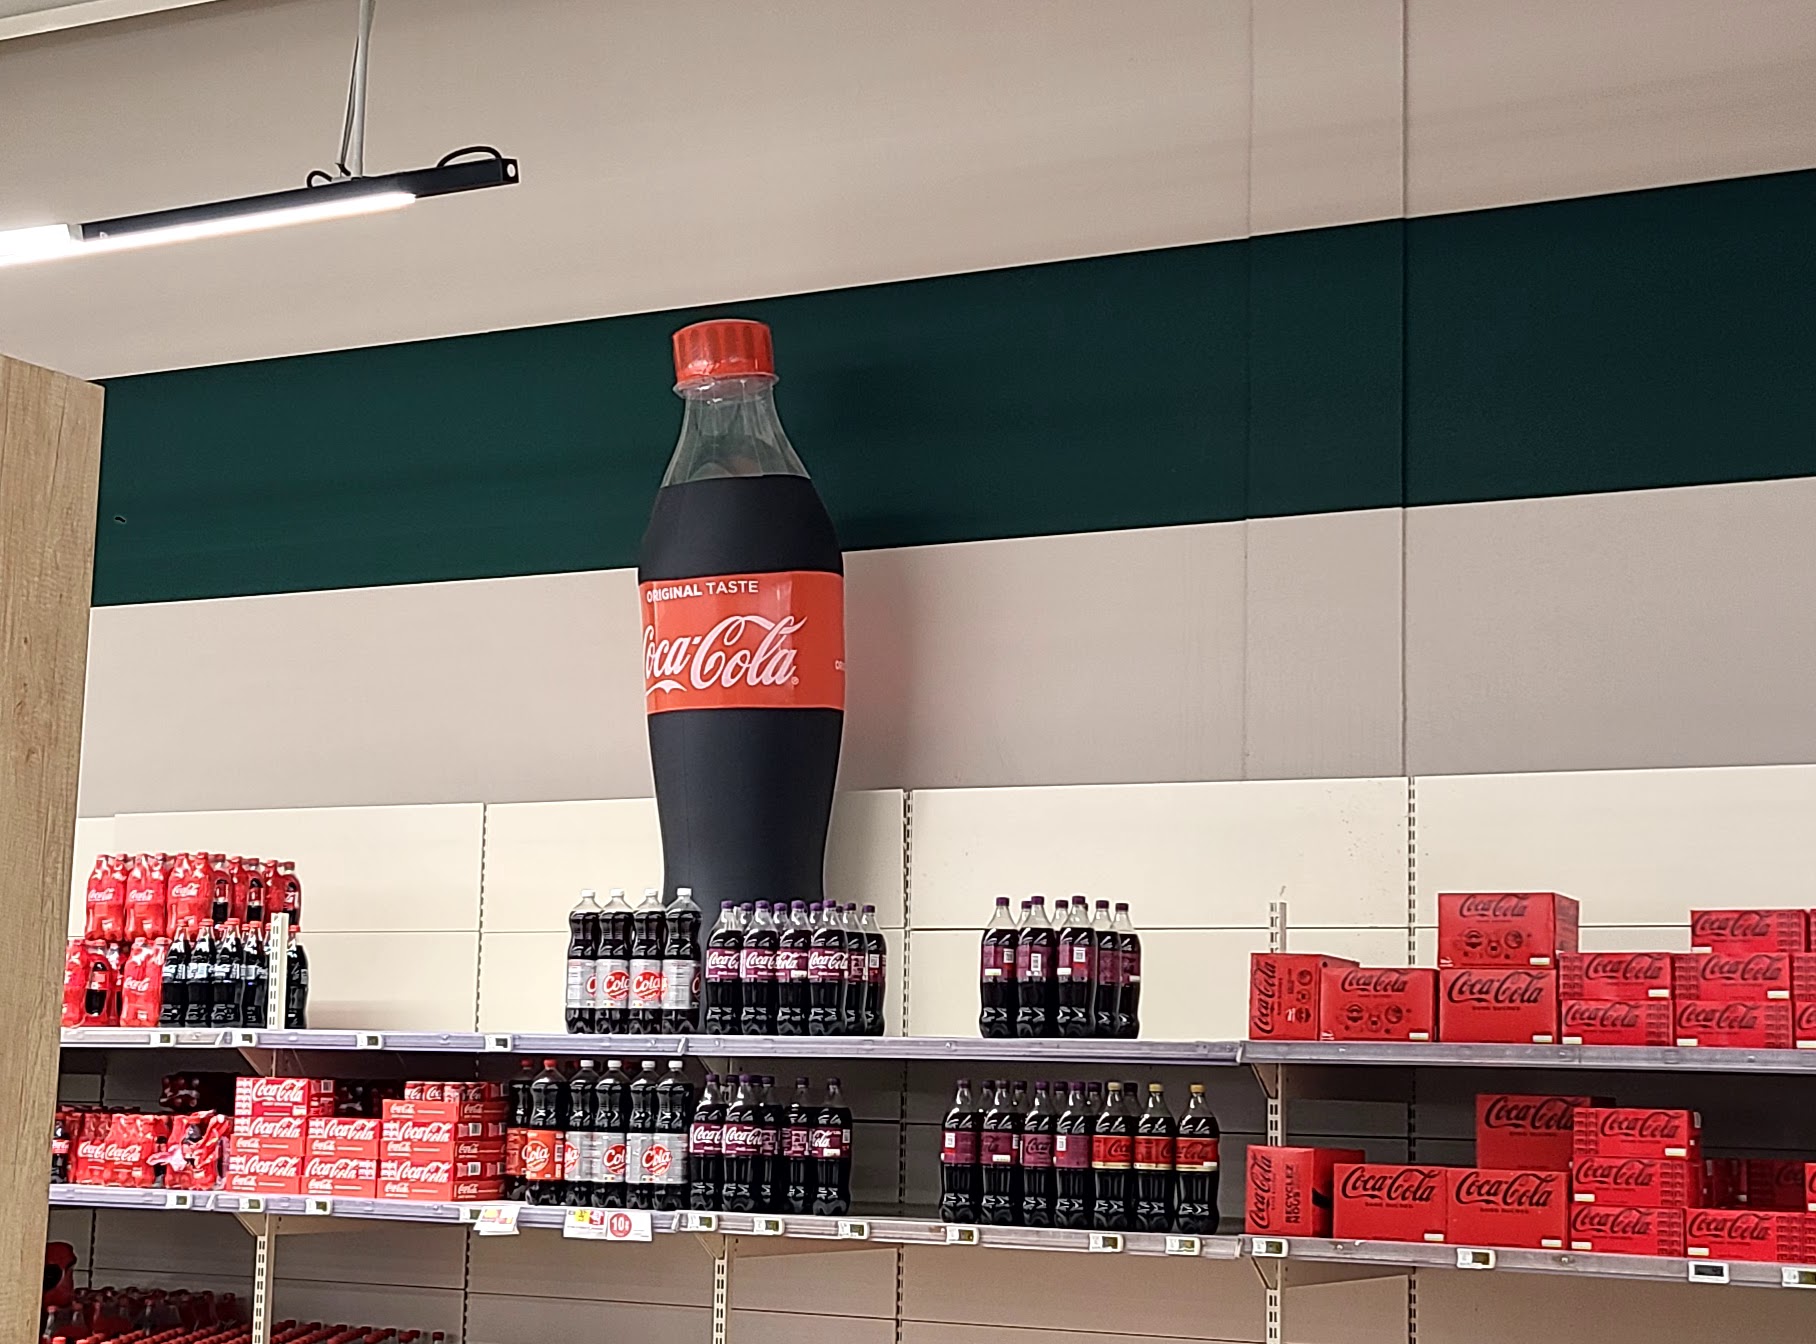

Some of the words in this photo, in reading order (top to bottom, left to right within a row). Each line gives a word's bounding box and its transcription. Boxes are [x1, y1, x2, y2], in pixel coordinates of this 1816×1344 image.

[646, 583, 703, 604] ORIGINAL
[705, 580, 759, 596] TASTE
[604, 1149, 626, 1166] Col
